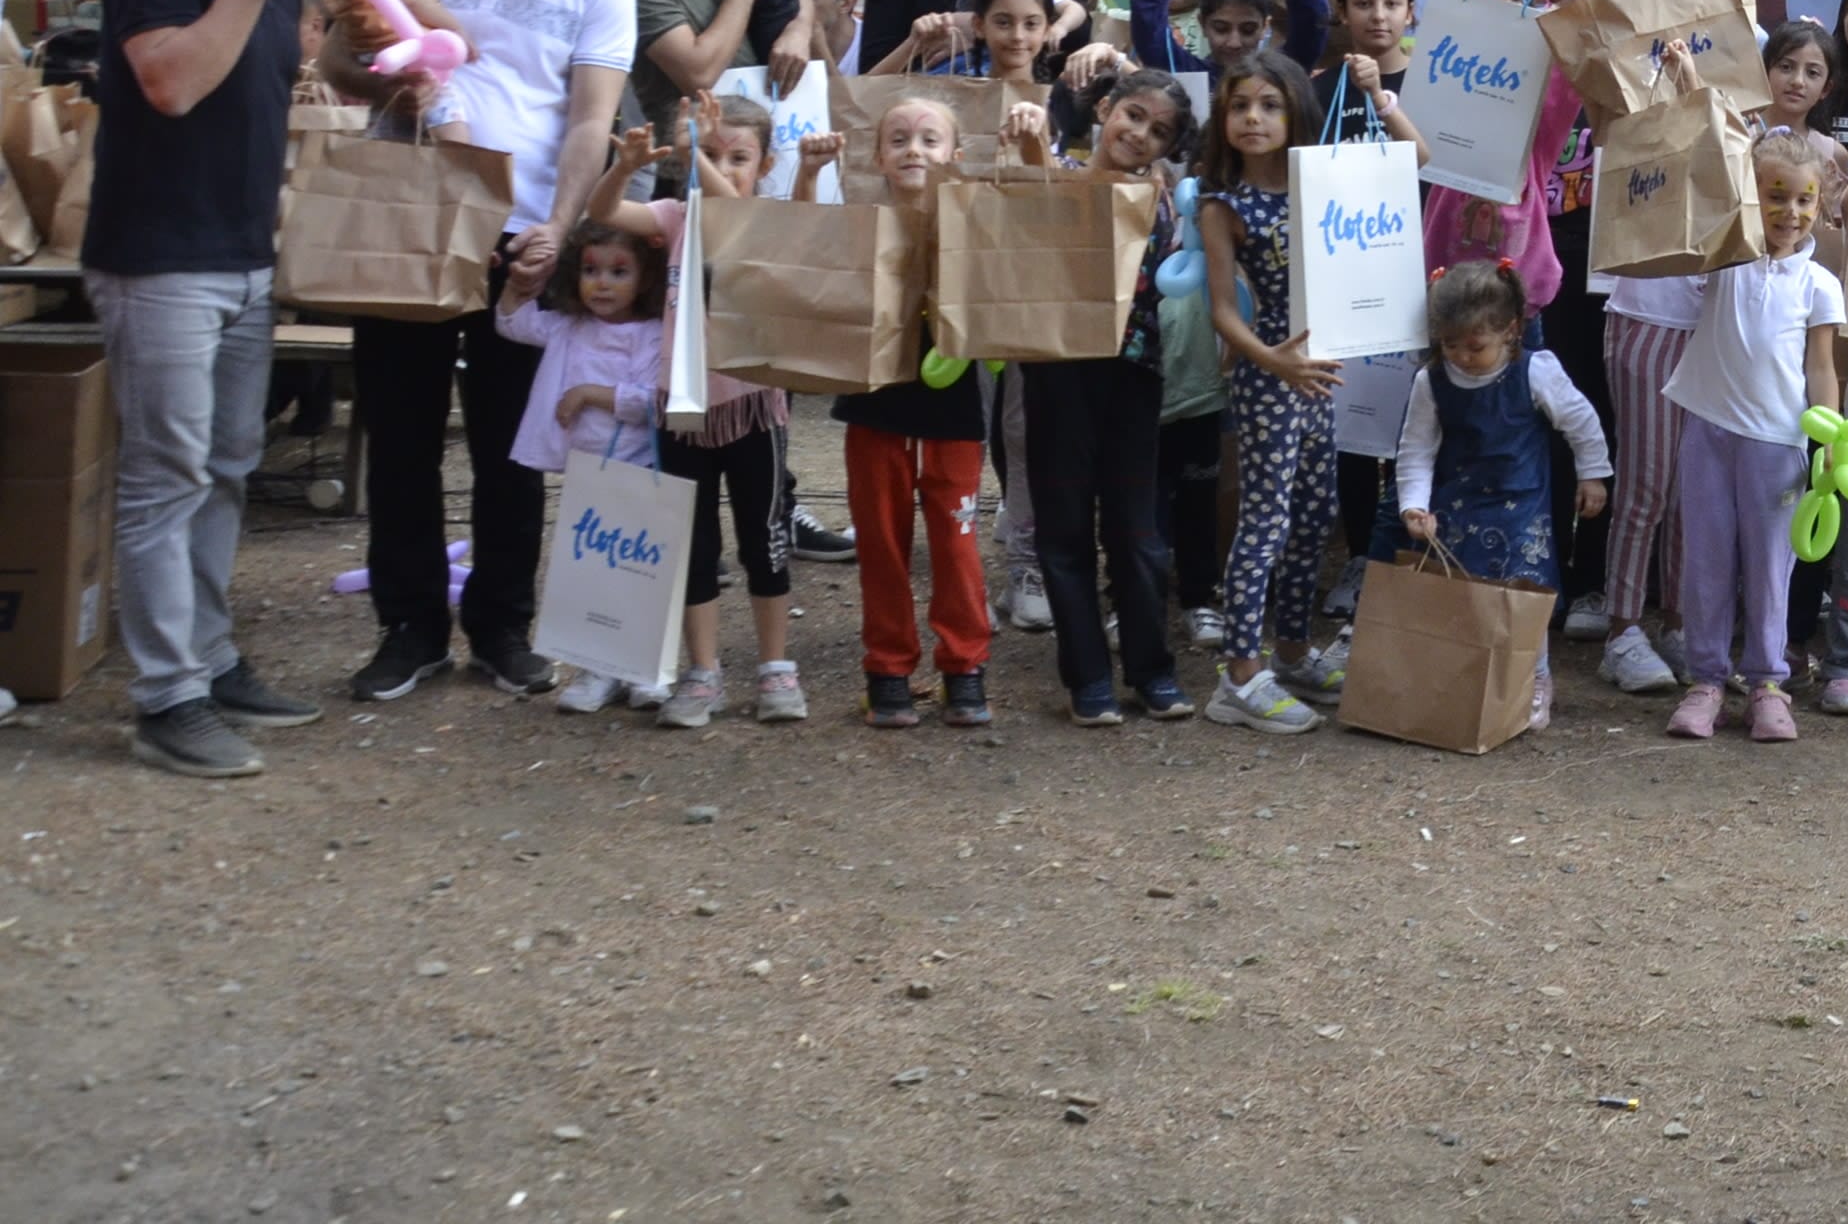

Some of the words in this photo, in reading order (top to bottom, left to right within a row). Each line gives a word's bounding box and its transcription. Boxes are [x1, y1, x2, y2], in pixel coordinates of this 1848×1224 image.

[1428, 35, 1521, 93] floteks
[1319, 199, 1405, 255] floteks
[572, 507, 661, 568] floteks
